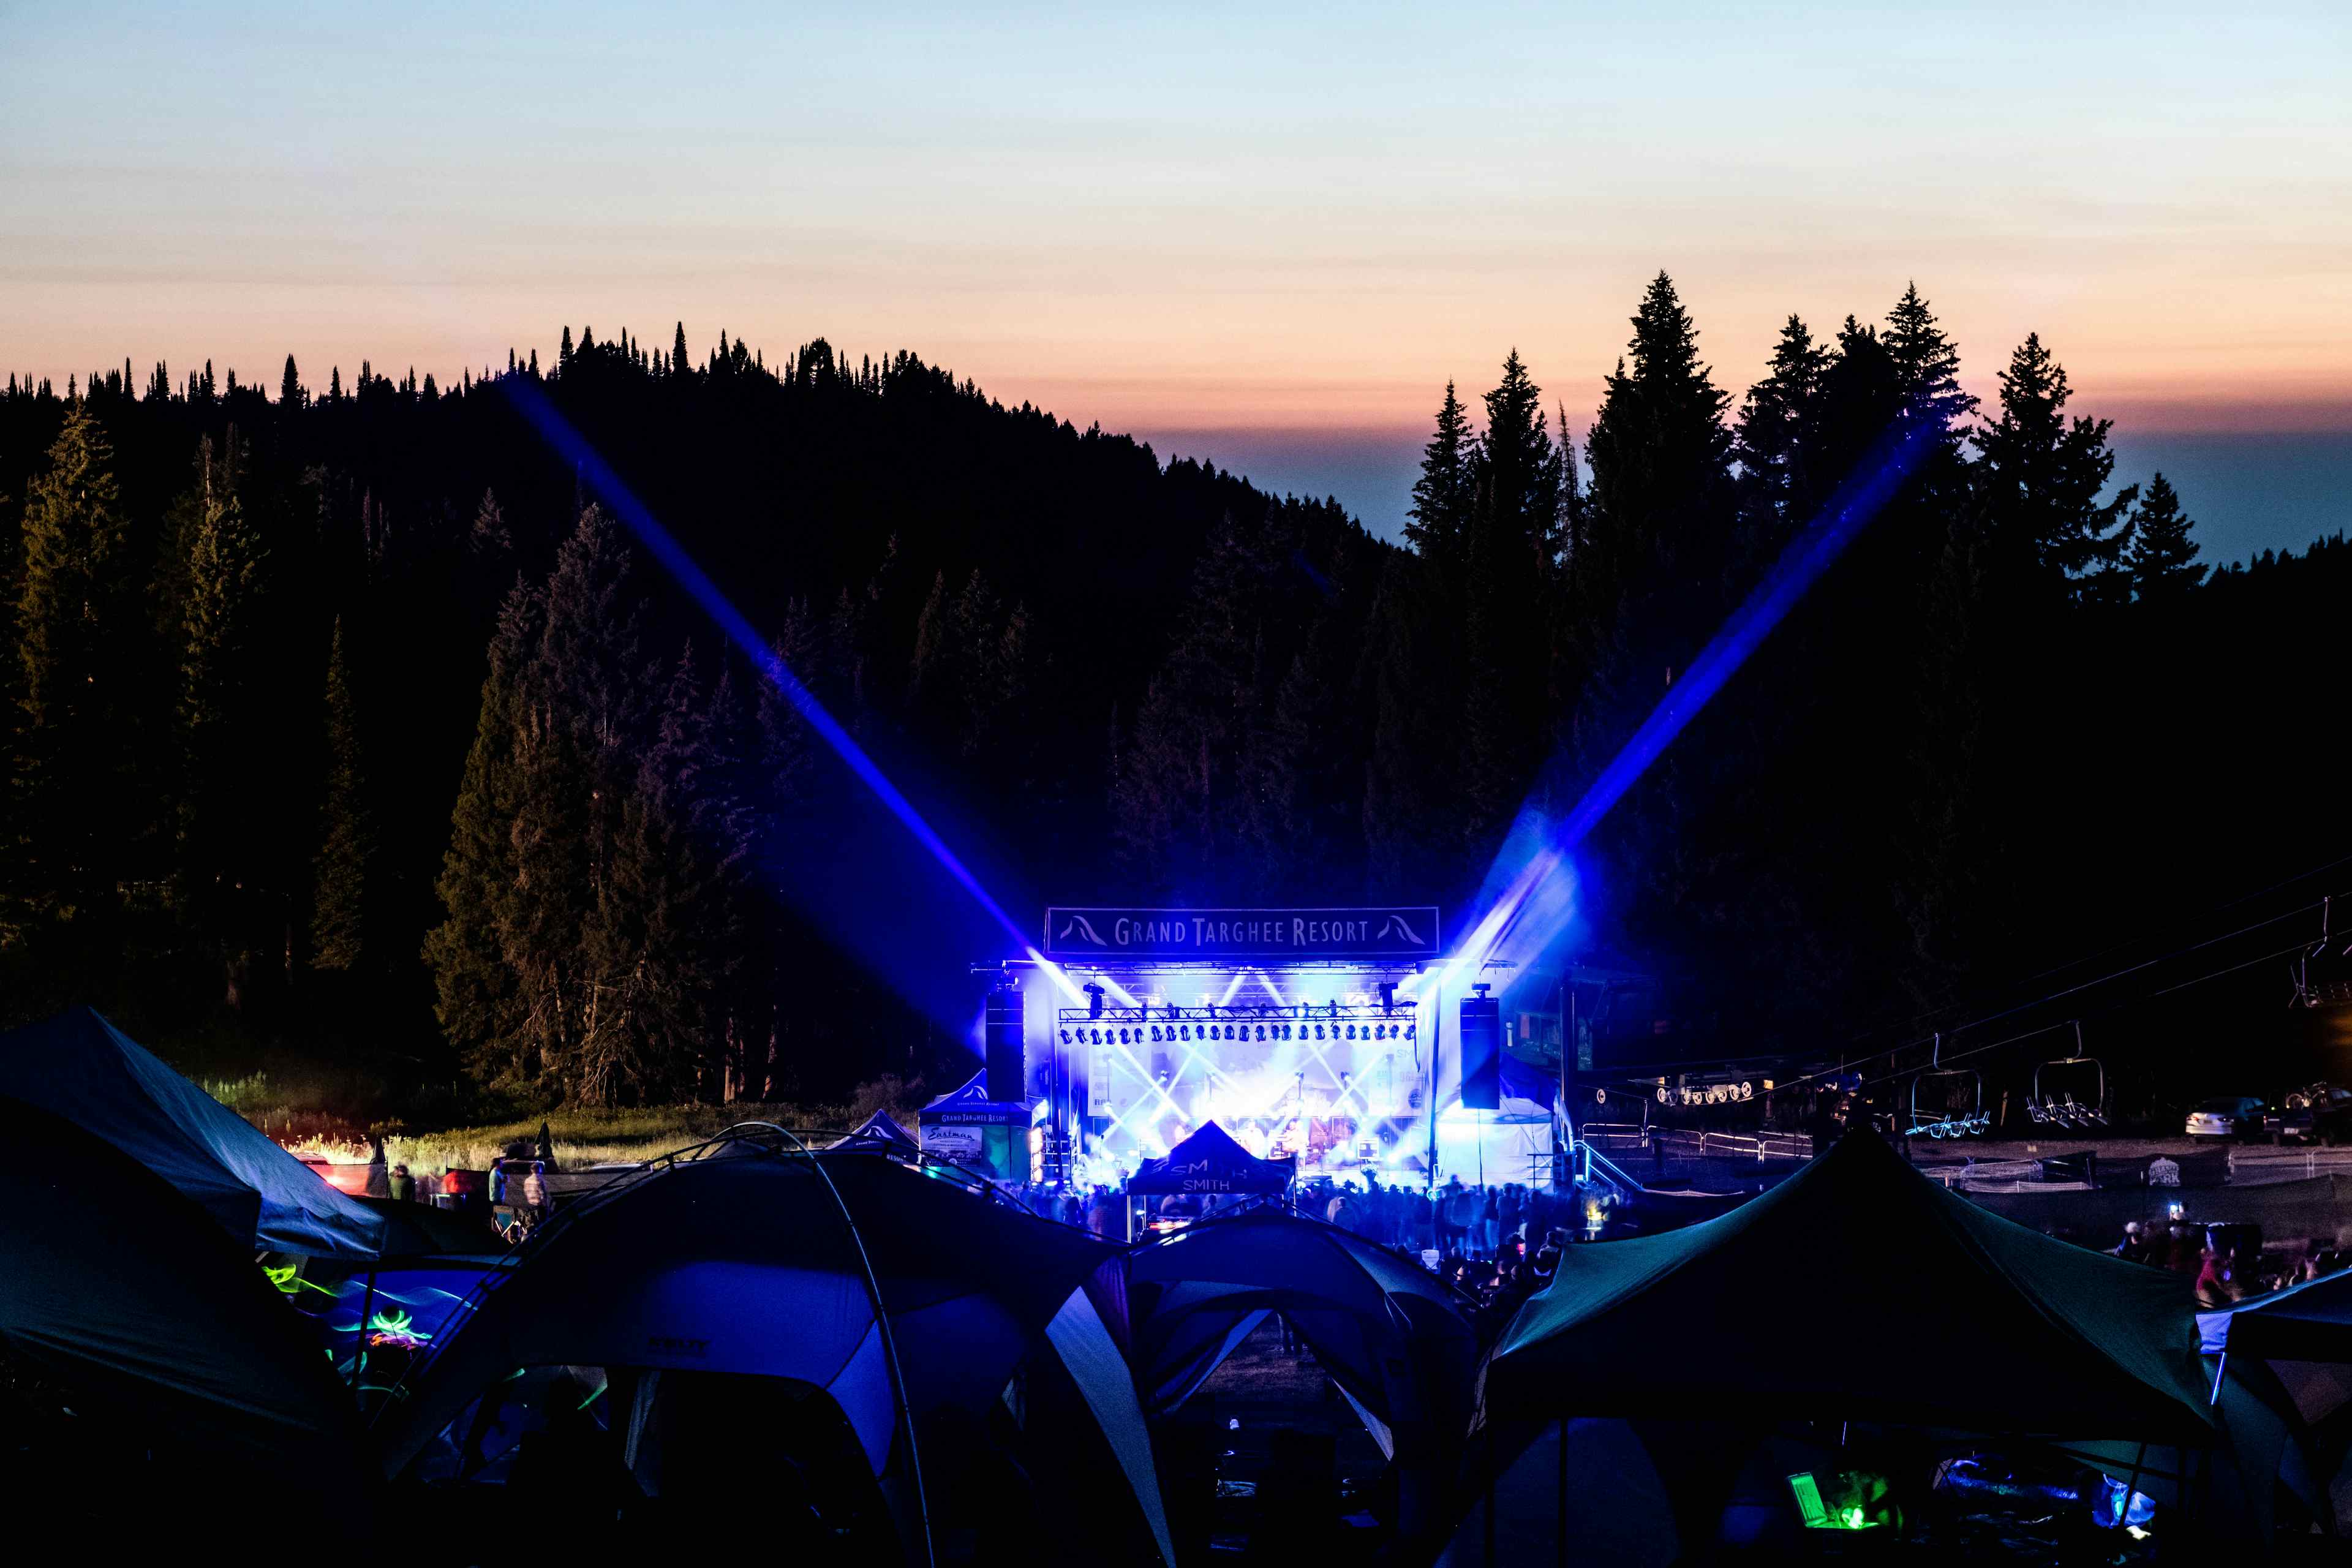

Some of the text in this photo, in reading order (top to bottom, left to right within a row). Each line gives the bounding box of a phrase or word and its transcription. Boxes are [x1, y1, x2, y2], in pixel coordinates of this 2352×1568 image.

[1115, 917, 1368, 946] GRAND TARGHEE RESORT
[1183, 1179, 1229, 1191] SMITH
